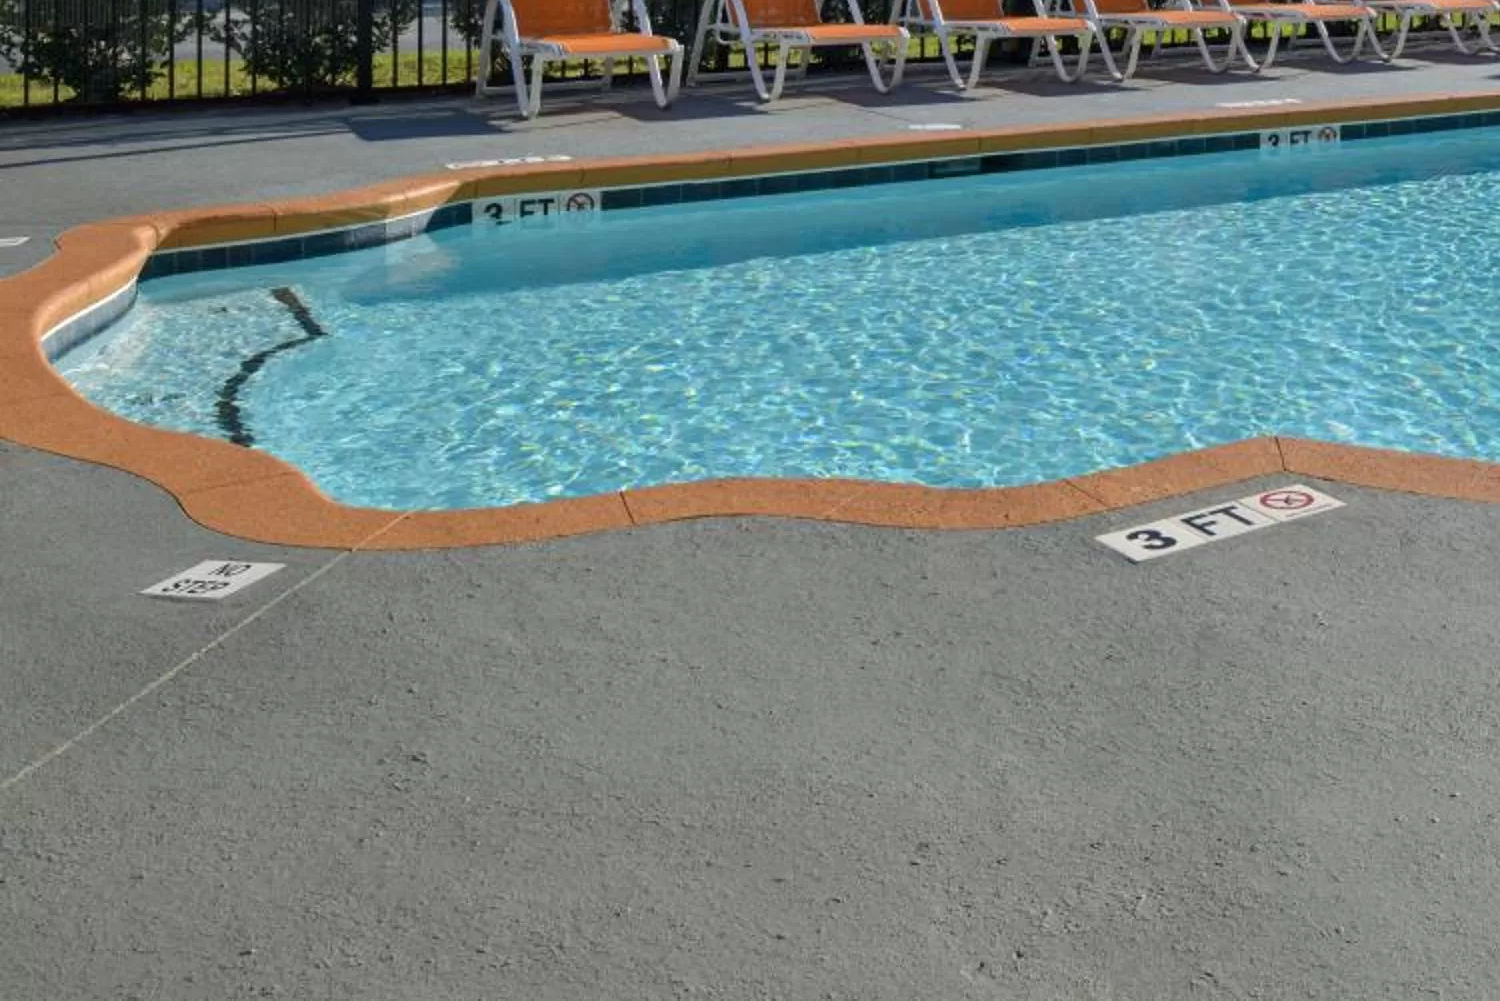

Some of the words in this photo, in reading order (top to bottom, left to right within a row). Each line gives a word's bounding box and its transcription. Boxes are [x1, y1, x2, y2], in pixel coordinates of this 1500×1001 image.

[483, 202, 508, 224] 3
[520, 198, 555, 217] FT
[1126, 528, 1177, 550] 3
[1180, 505, 1255, 536] FT
[207, 562, 252, 577] NO
[161, 578, 230, 594] STEP
